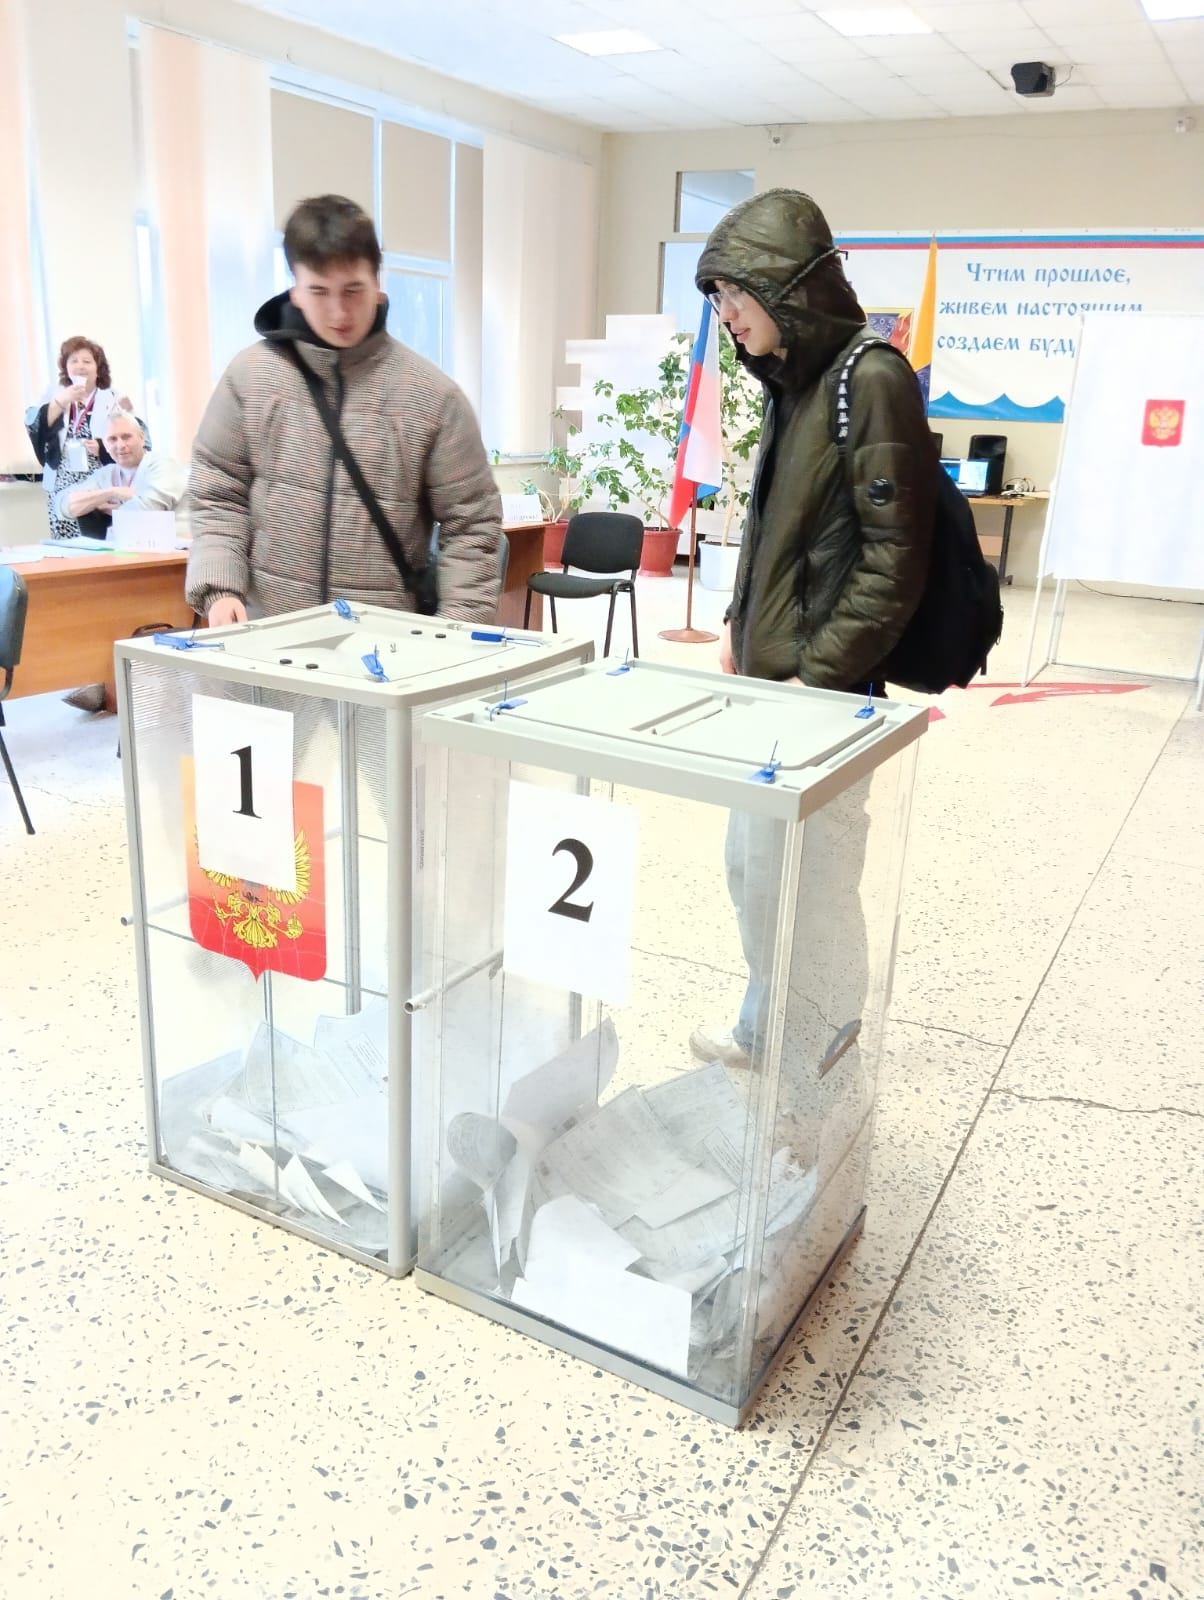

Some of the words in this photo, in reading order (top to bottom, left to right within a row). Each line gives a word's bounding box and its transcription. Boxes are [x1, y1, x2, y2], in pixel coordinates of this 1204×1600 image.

[966, 262, 1026, 283] Чтим
[1034, 267, 1132, 288] прошлое,
[938, 301, 1008, 316] живем
[936, 335, 1020, 353] создаем
[230, 745, 262, 820] 1
[548, 838, 594, 923] 2
